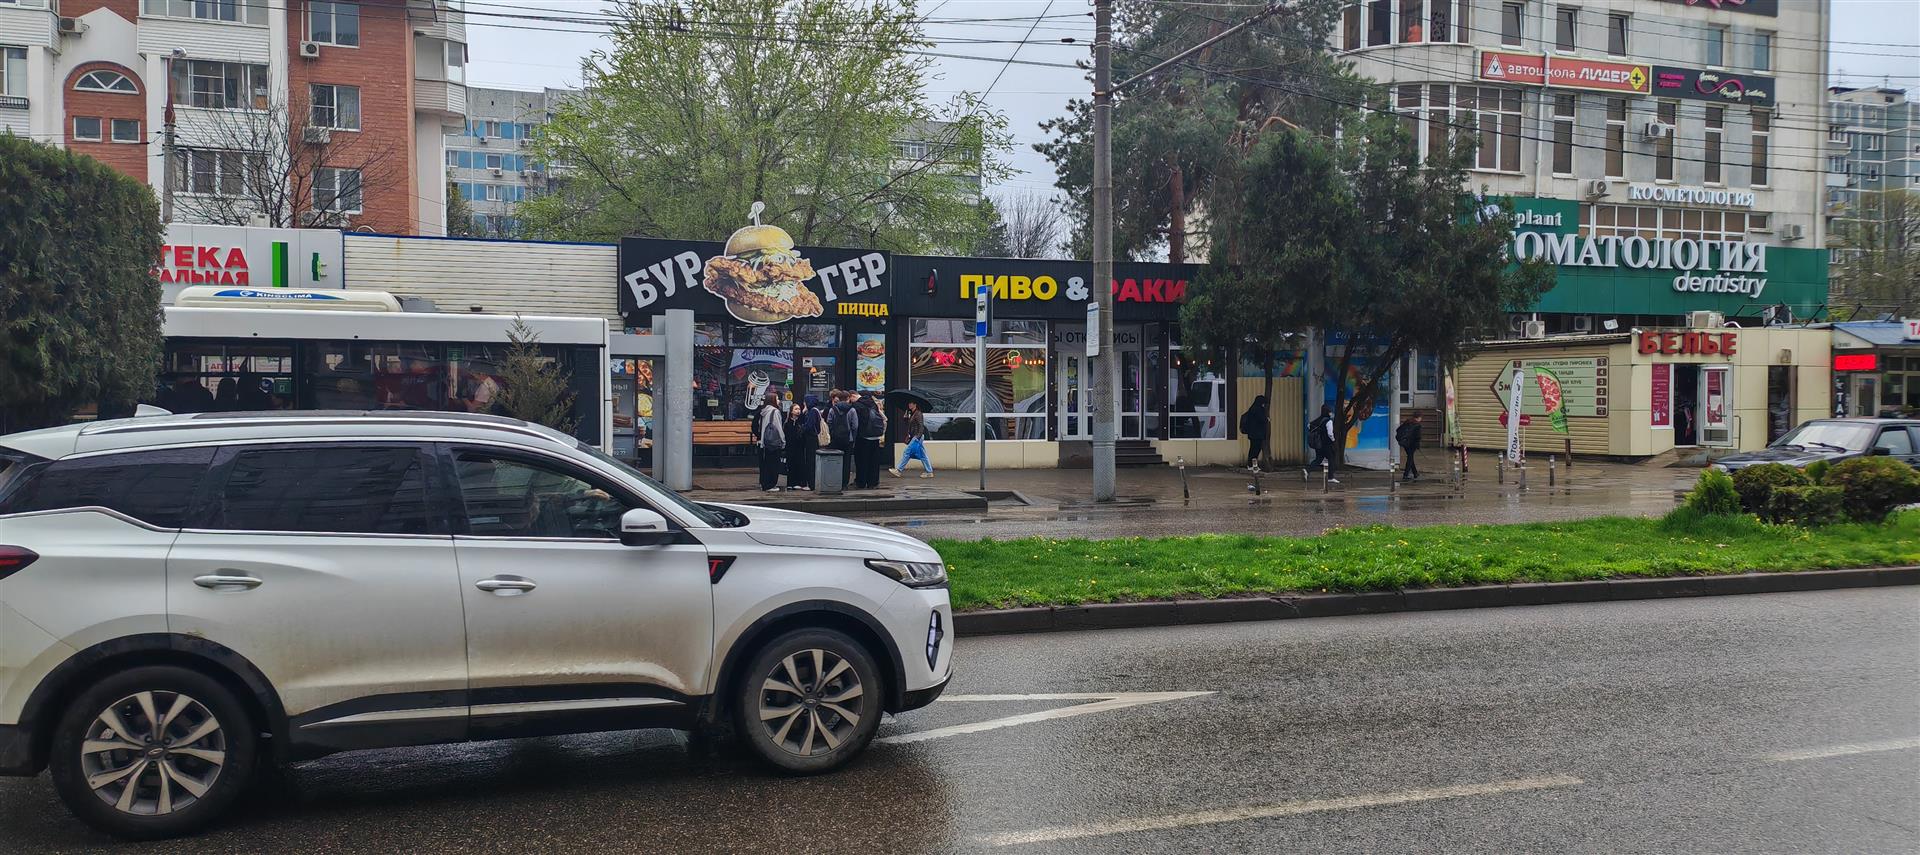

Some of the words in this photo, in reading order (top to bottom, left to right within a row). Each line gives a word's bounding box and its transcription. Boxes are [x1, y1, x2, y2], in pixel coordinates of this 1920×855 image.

[1508, 64, 1576, 79] автошкола
[1579, 67, 1631, 83] ЛИДЕР
[1631, 185, 1755, 207] КОСМЕТОЛОГИЯ
[1509, 230, 1768, 273] ОМАТОЛОГИЯ
[624, 250, 702, 309] БУР
[816, 252, 887, 302] ГЕР
[960, 274, 1058, 301] ПИВО
[1065, 276, 1089, 300] &
[1673, 271, 1767, 298] dentistry
[837, 302, 889, 317] ПИЦЦА
[1639, 332, 1737, 355] БЕЛЬЕ
